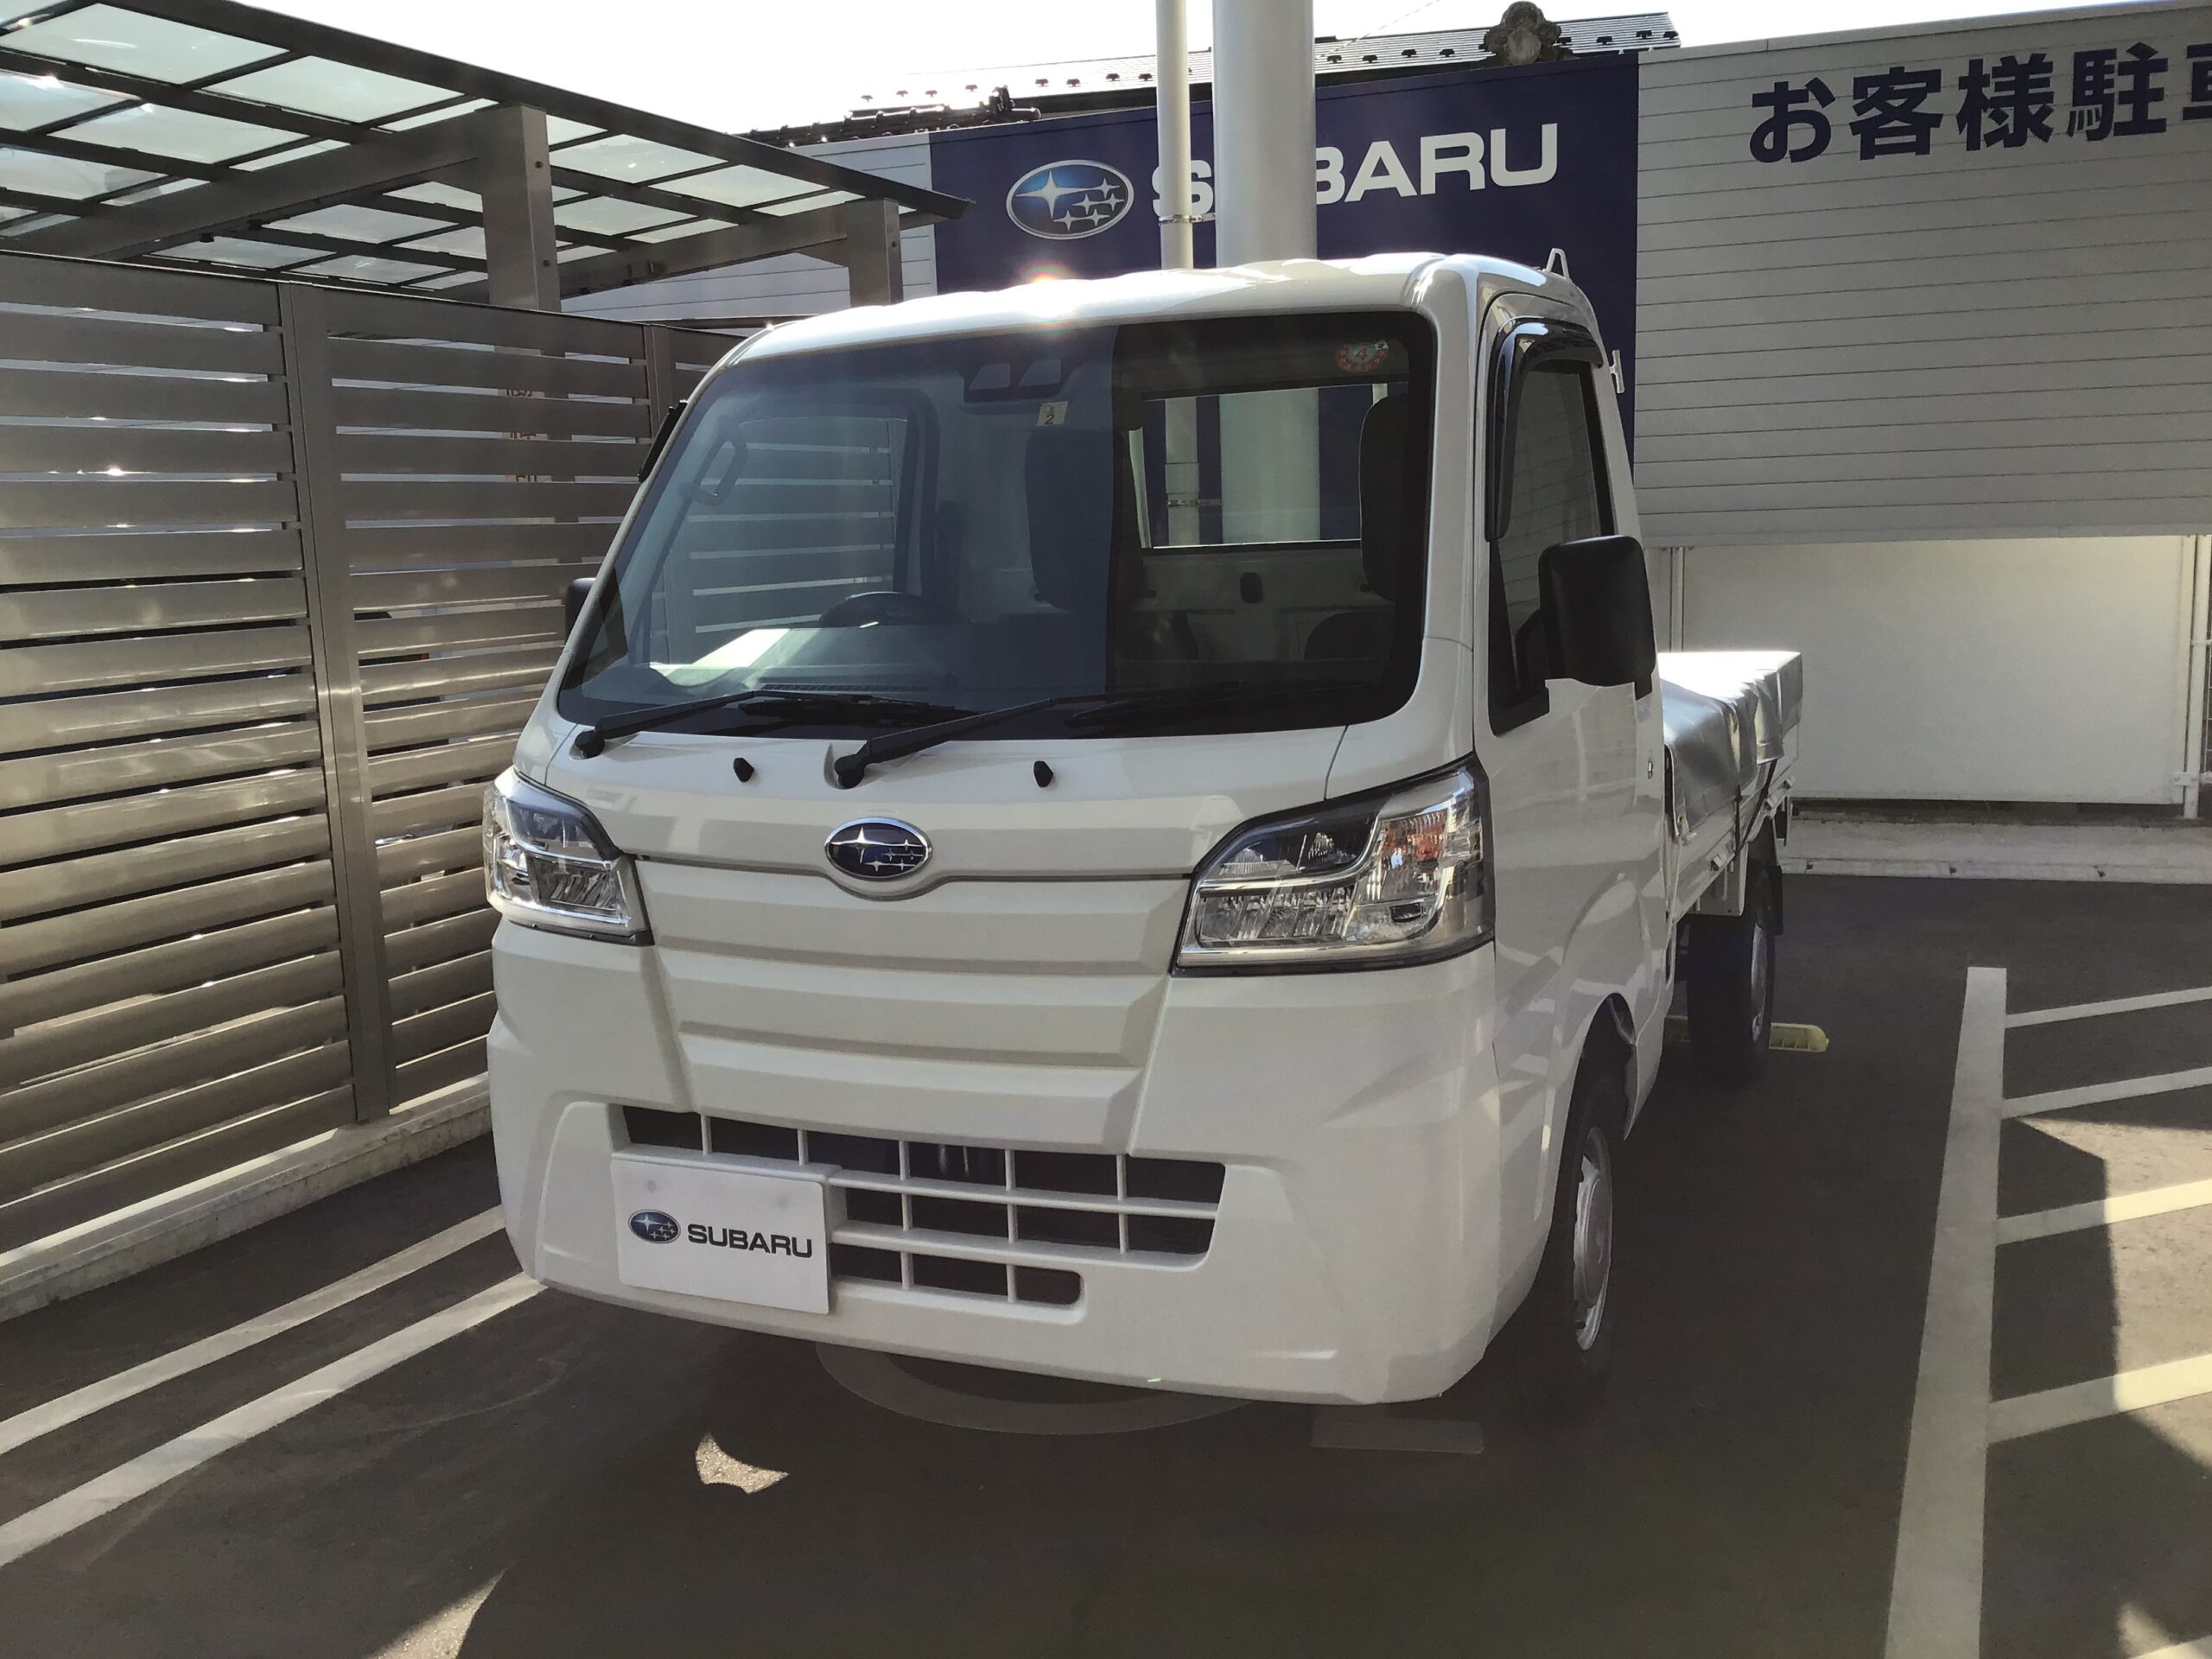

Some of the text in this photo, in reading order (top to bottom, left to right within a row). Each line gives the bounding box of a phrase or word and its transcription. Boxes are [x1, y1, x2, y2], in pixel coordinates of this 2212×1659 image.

[1749, 41, 2212, 163] お客様駐
[1152, 123, 1557, 218] SBARU
[688, 1224, 812, 1258] SUBARU
